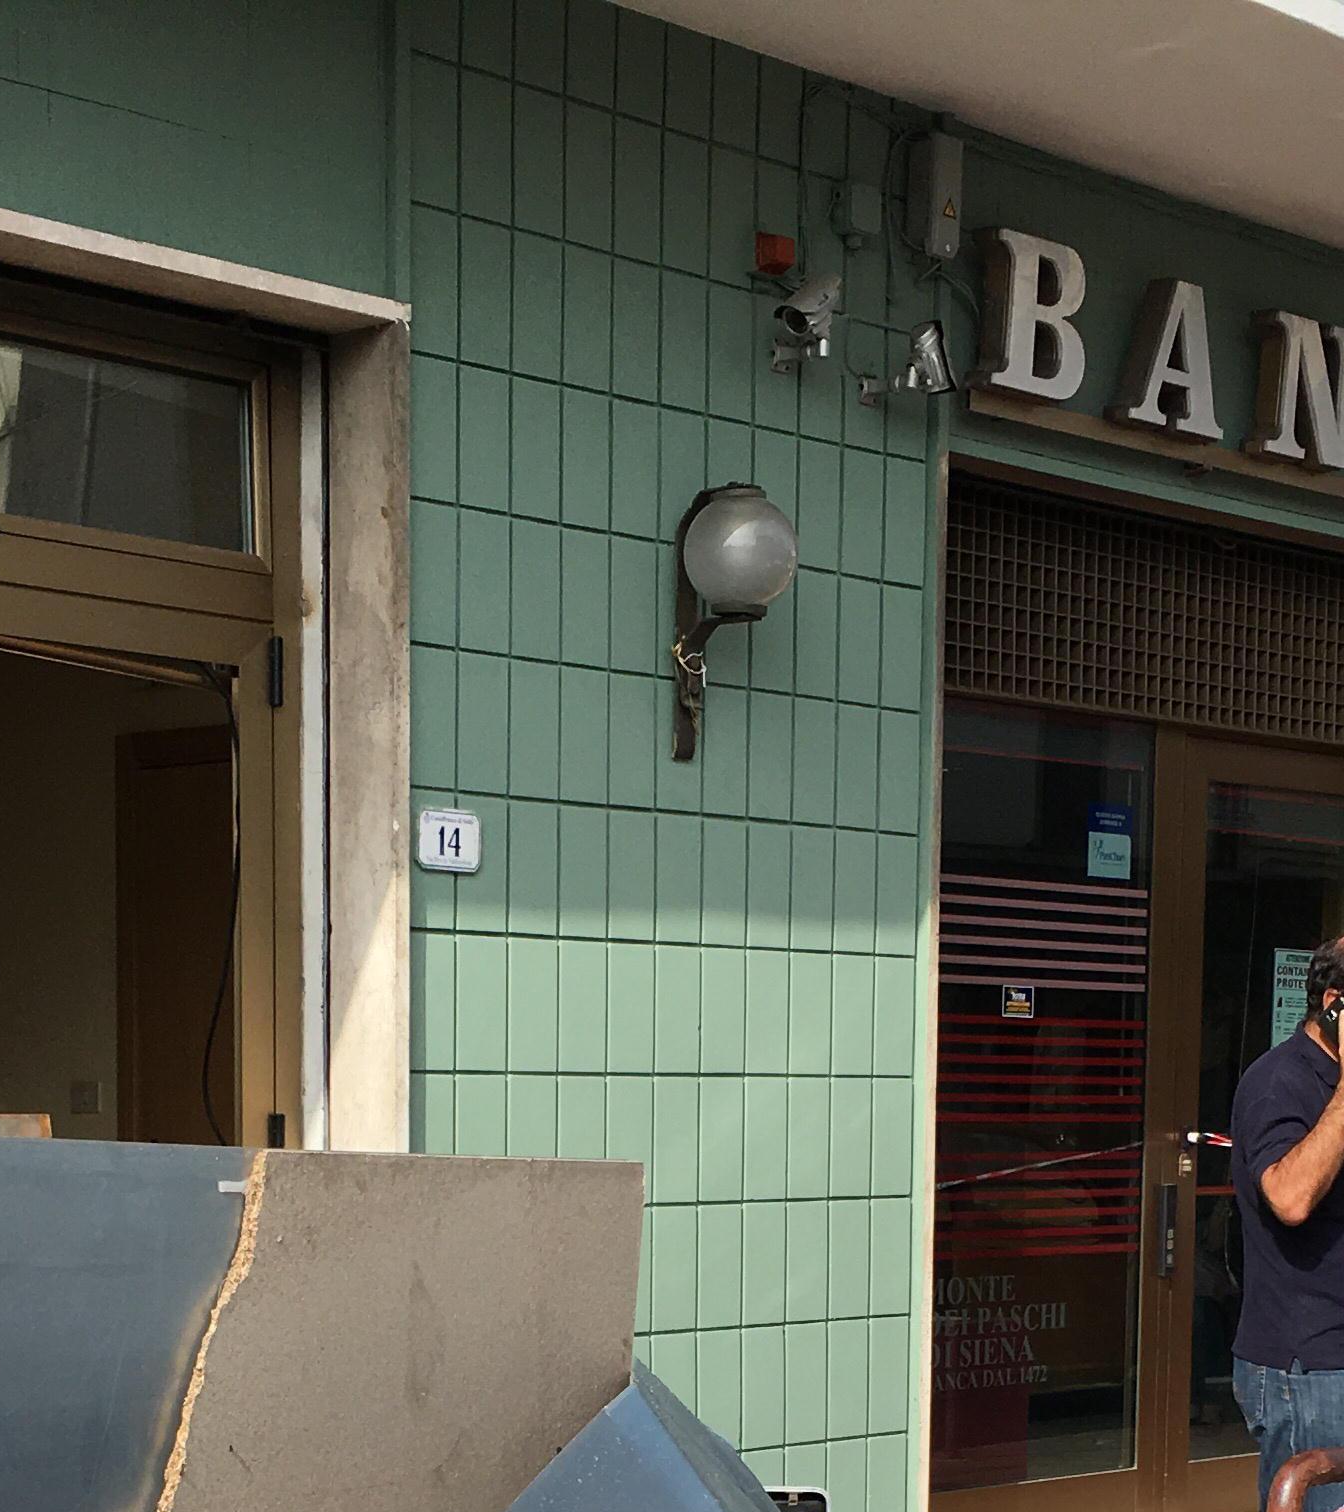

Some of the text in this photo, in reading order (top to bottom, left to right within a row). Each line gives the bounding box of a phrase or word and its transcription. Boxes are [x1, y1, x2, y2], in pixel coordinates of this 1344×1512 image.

[439, 826, 461, 857] 14
[1276, 977, 1306, 989] PROTE
[1277, 965, 1307, 977] CONTA
[978, 1302, 1067, 1334] PASCHI
[960, 1335, 1034, 1368] SIENA
[984, 1368, 1016, 1387] DAL
[1019, 1364, 1048, 1384] 1472
